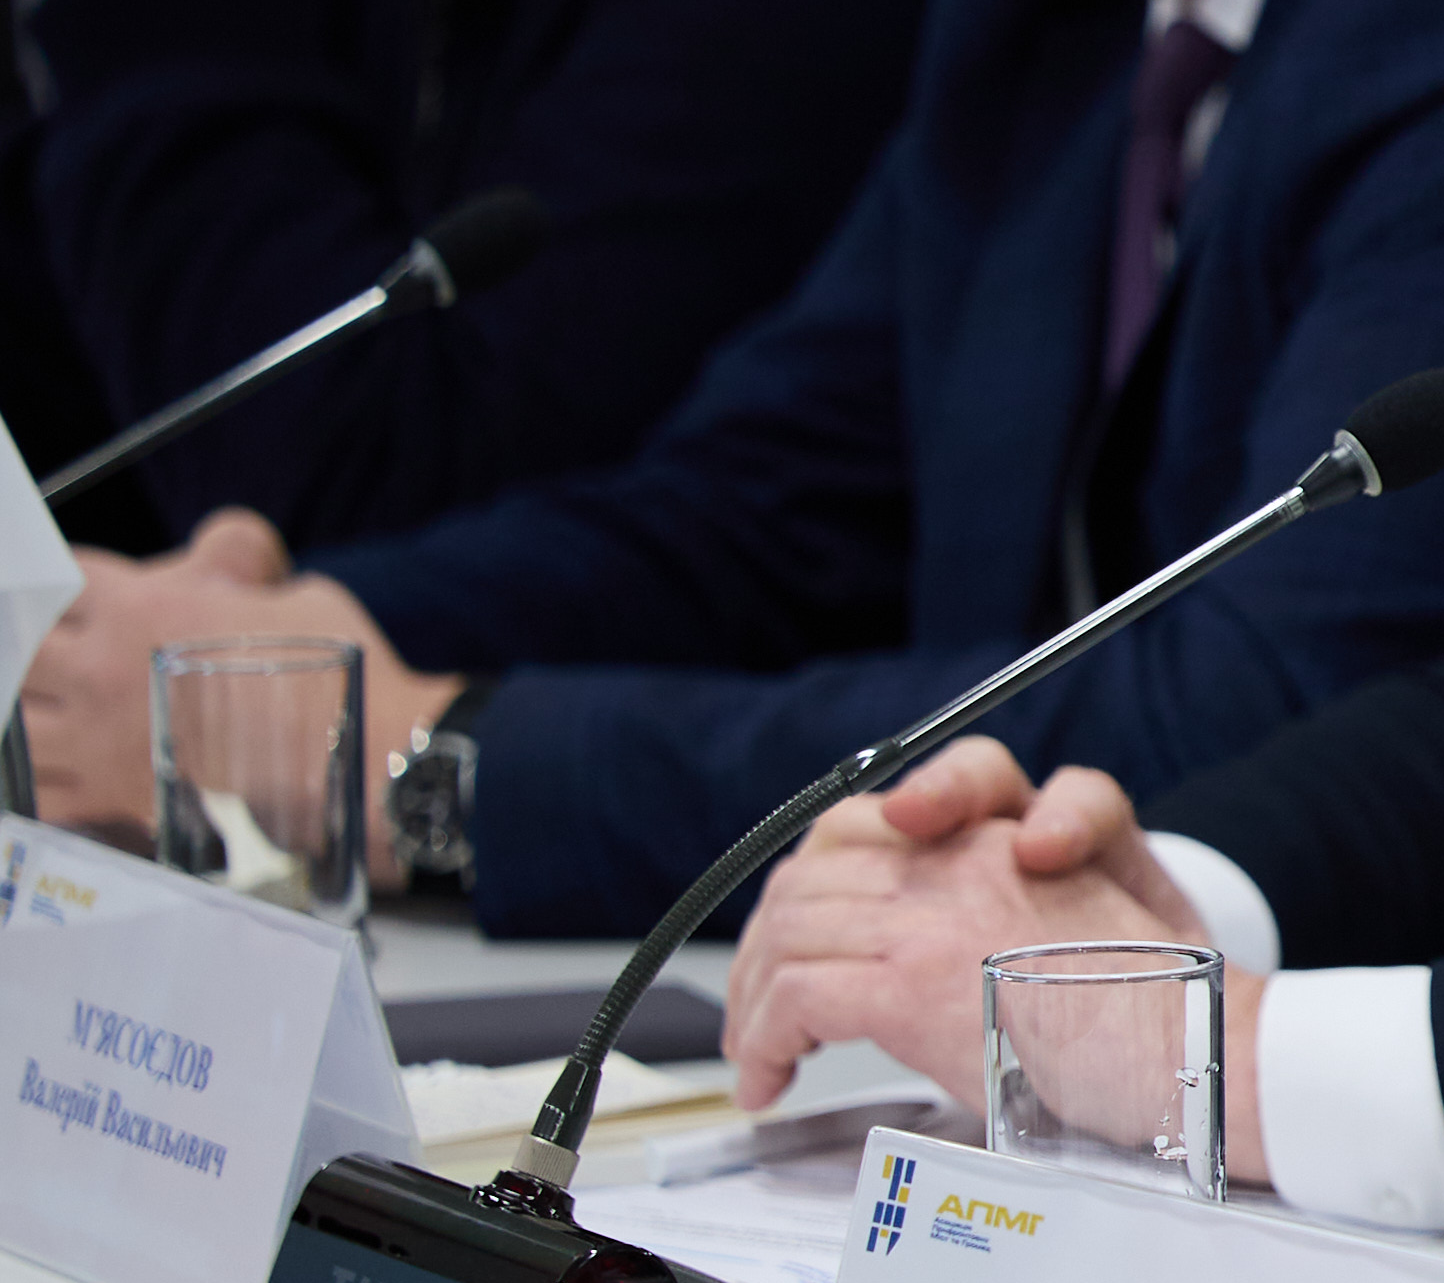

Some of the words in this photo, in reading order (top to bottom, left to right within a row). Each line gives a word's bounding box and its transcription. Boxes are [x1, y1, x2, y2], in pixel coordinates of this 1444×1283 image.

[19, 1055, 101, 1133] Валерій
[102, 1088, 228, 1179] Васильович
[936, 1194, 1045, 1236] АПМГ
